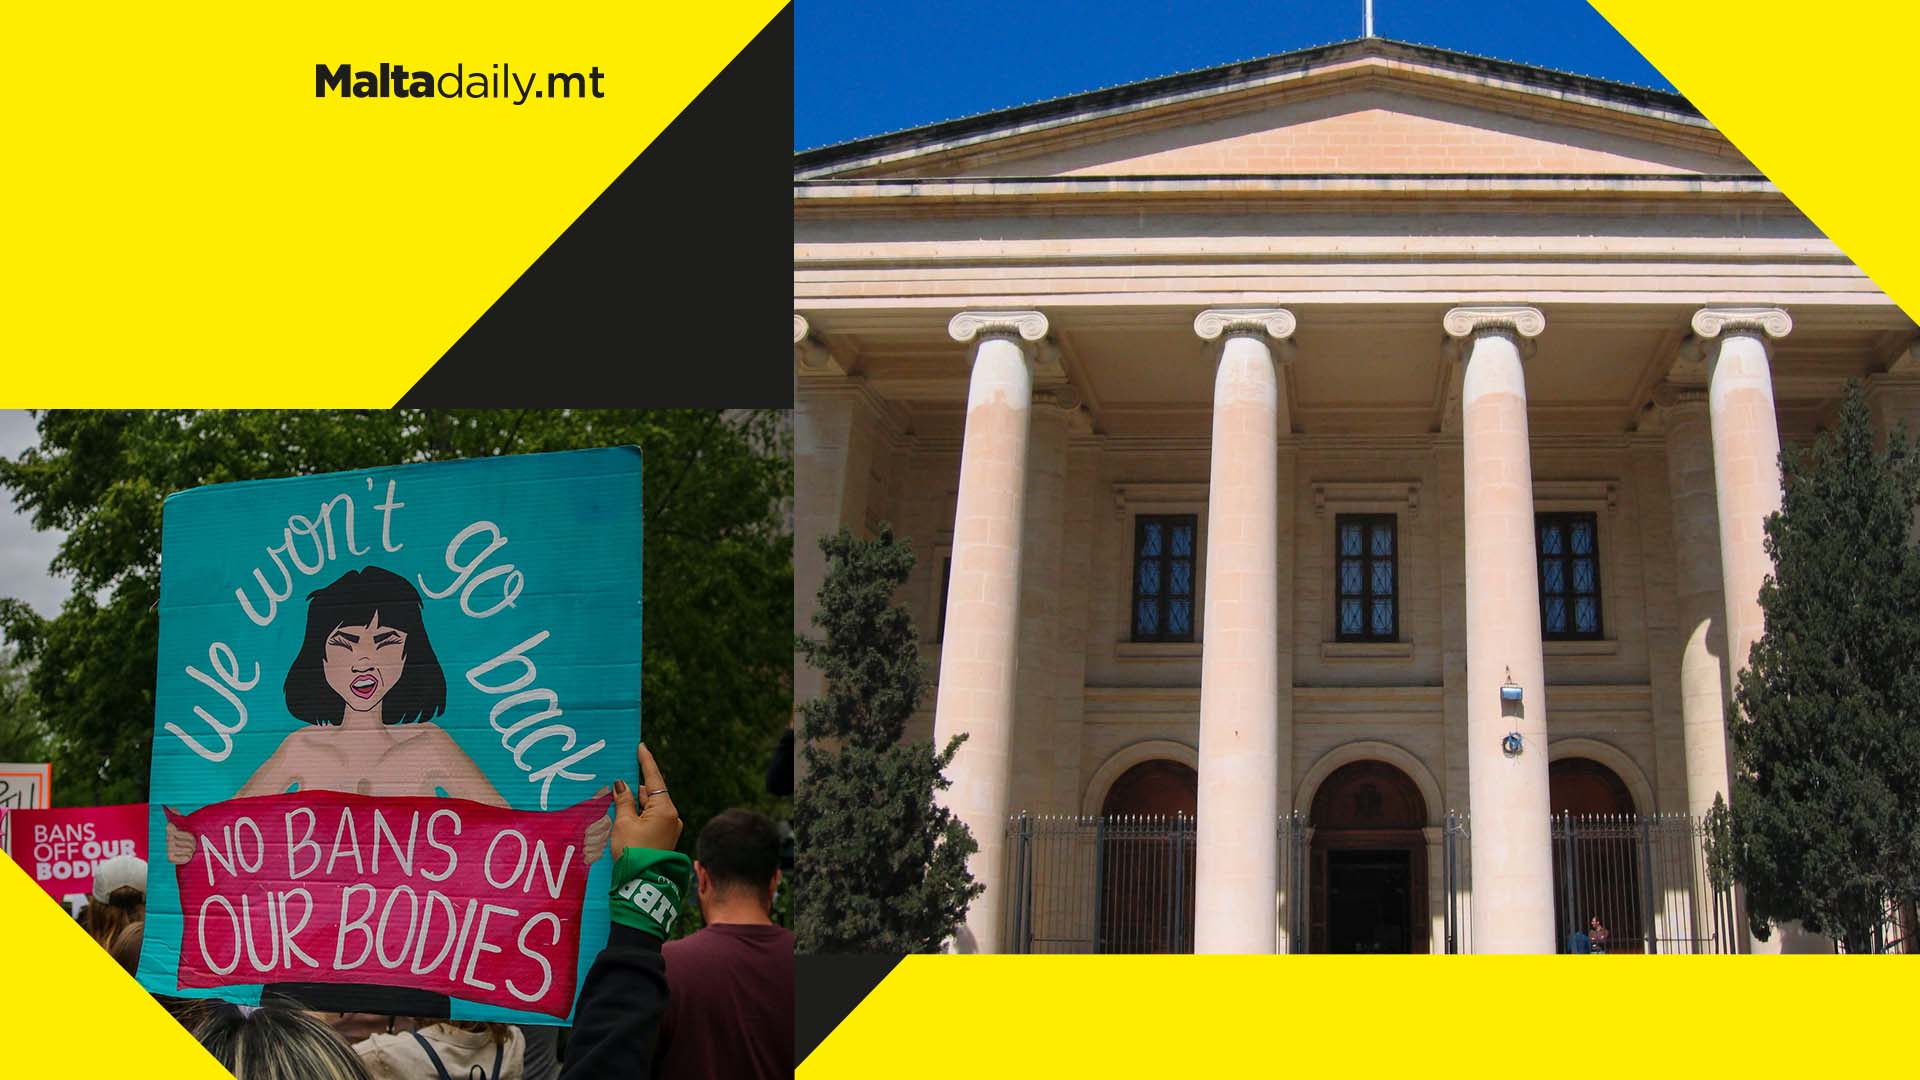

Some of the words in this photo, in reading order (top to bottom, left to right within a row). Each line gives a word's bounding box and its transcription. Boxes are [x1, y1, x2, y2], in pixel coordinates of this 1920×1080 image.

[235, 477, 405, 626] won't
[417, 520, 524, 618] go
[164, 641, 261, 762] We
[465, 630, 606, 810] back
[33, 842, 80, 861] OFF
[82, 839, 136, 859] OUR
[34, 823, 96, 843] BANS
[36, 859, 100, 880] BODI
[200, 817, 264, 886] NO
[285, 806, 462, 881] BANS
[484, 829, 575, 899] ON
[198, 887, 319, 976] OUR
[333, 884, 562, 1002] BODIES
